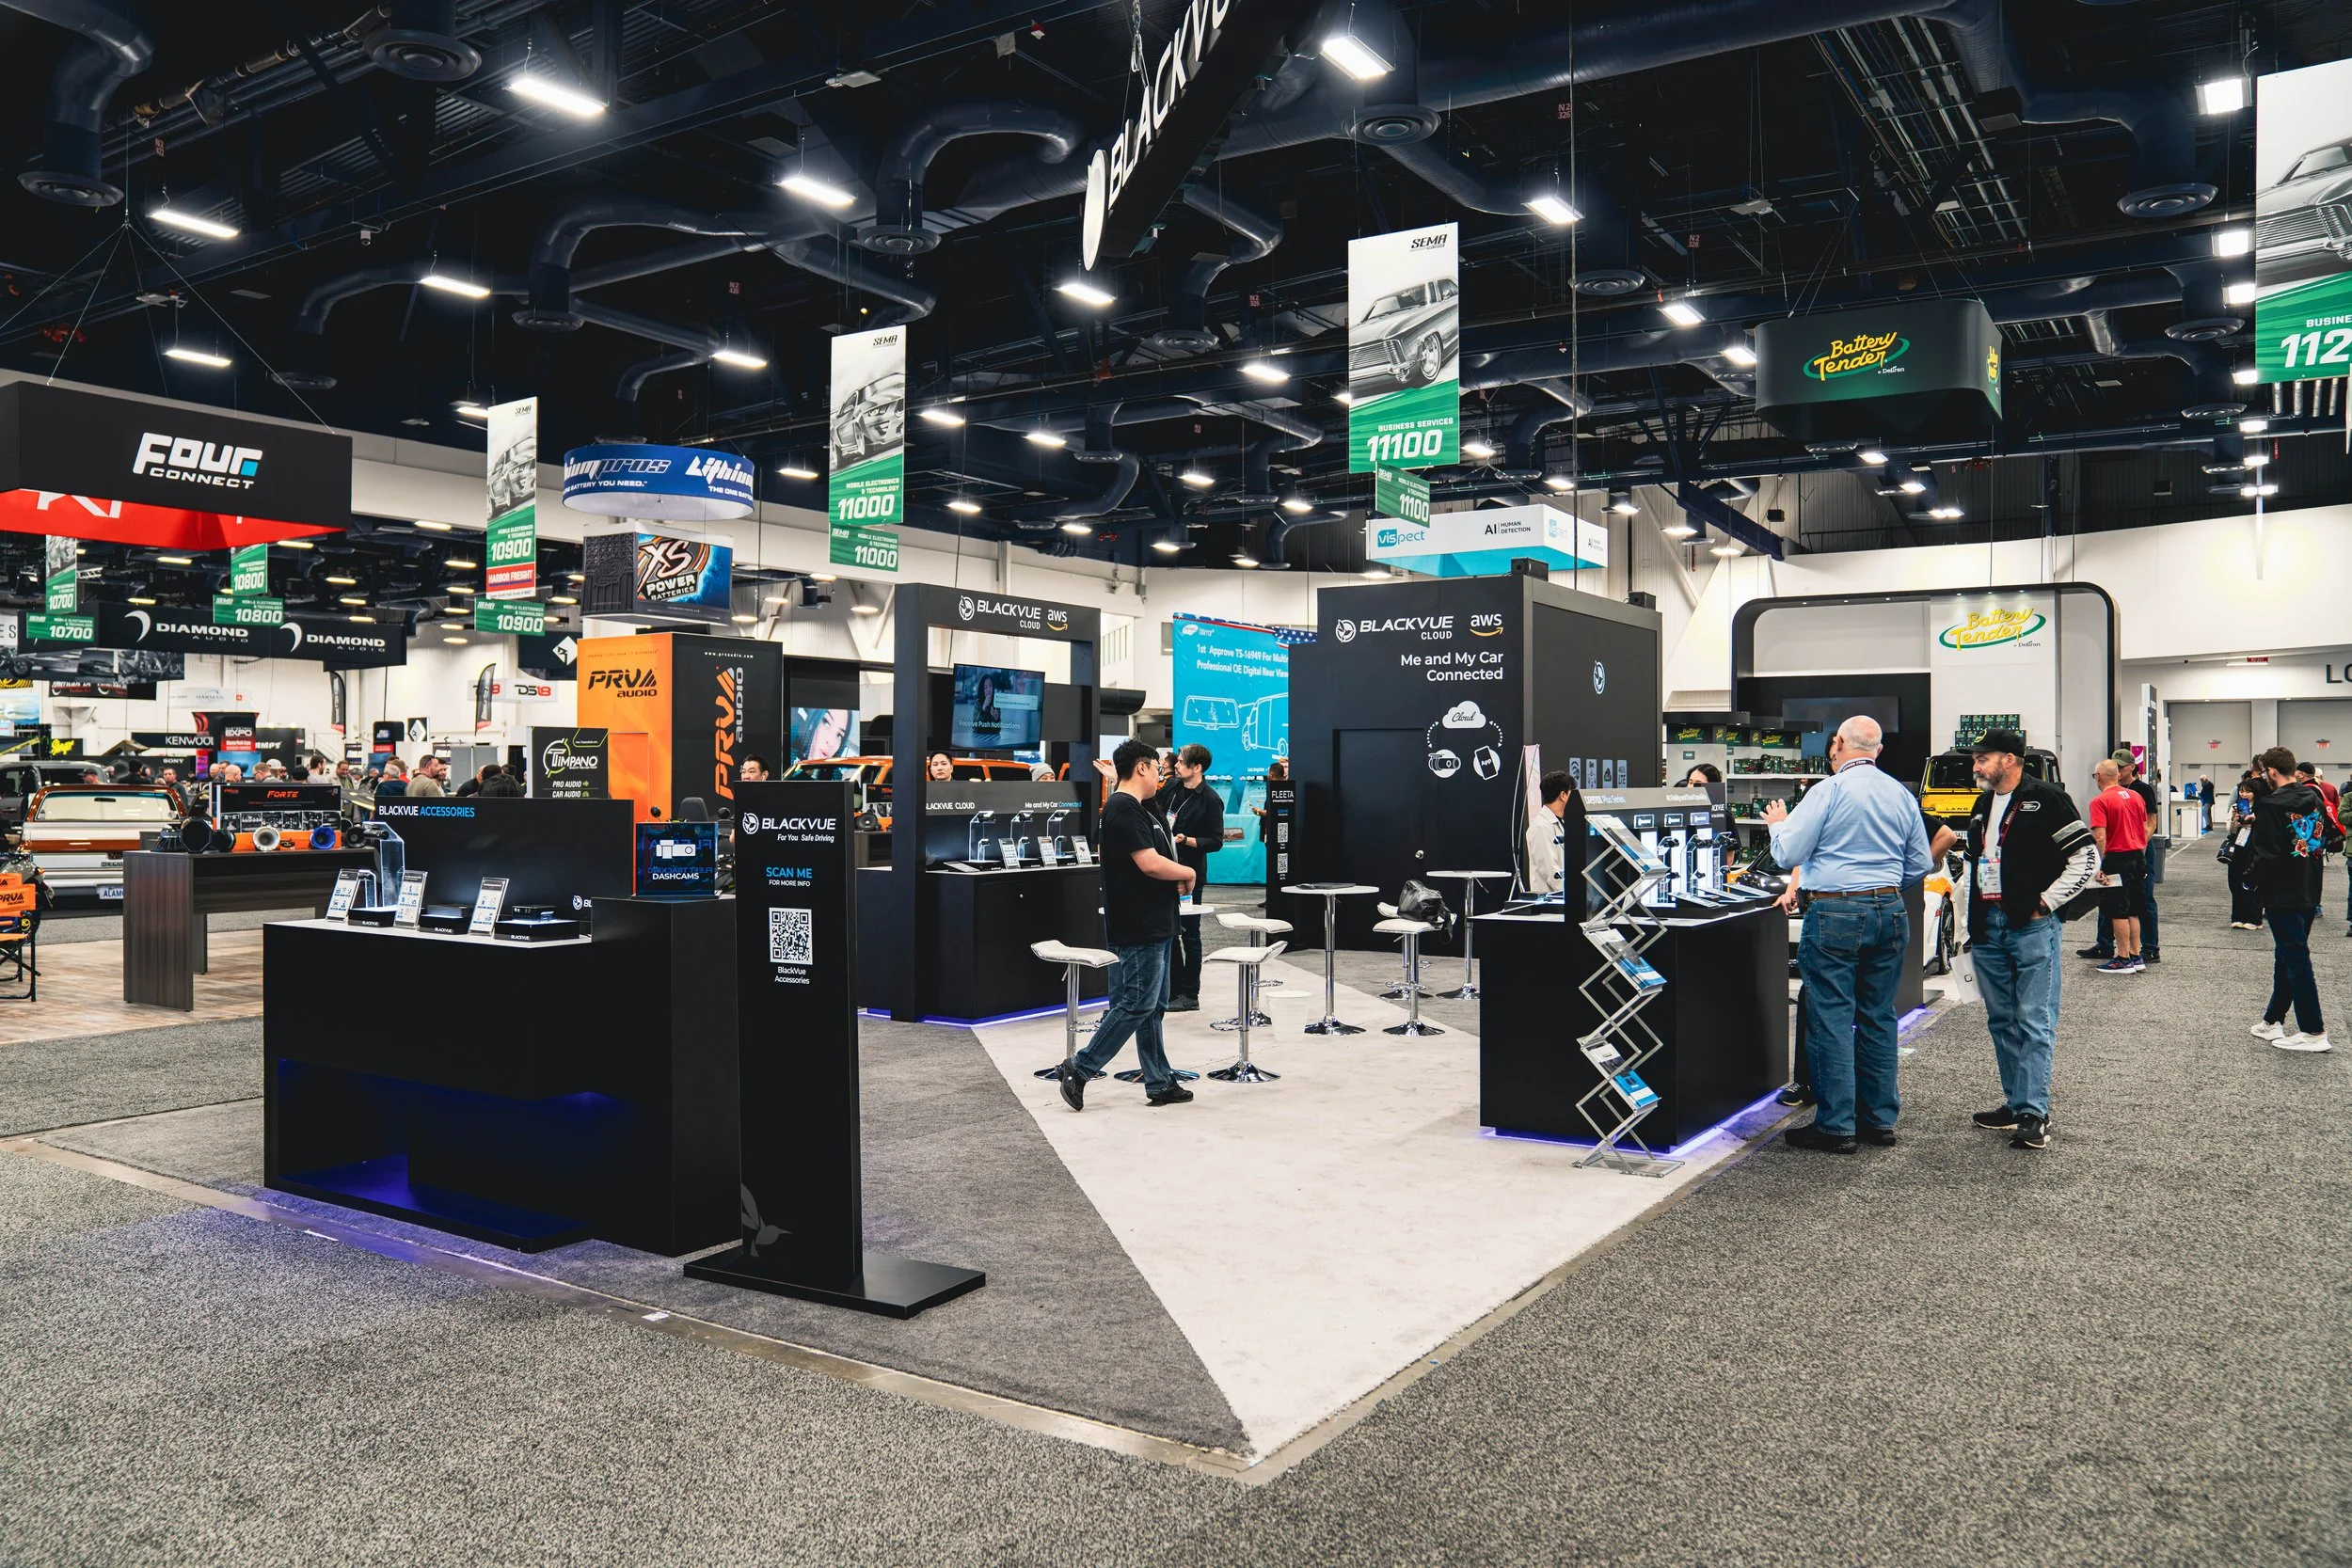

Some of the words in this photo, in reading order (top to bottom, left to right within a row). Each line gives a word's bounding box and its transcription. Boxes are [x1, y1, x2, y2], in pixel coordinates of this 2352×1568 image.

[1558, 111, 1570, 119] 326
[1411, 234, 1447, 248] SEMA
[2306, 314, 2352, 328] BUSINE
[873, 335, 898, 345] SEMA
[1831, 332, 1898, 358] Battery
[2280, 327, 2352, 368] 112
[1814, 349, 1885, 381] Tender
[515, 404, 532, 415] SEMA
[1377, 421, 1415, 432] BUSINESS
[1417, 418, 1454, 428] SERVICES
[1366, 429, 1442, 462] 11100
[133, 432, 263, 476] FOUR
[150, 467, 254, 489] CONNECT
[846, 481, 865, 489] MOBILE
[865, 478, 899, 487] ELECTRONICS
[571, 482, 596, 491] BATTERY
[724, 487, 738, 496] ONE
[866, 485, 899, 494] TECHNOLOGY
[838, 494, 895, 520] 11000
[1400, 494, 1429, 522] 11100
[1485, 524, 1497, 535] AI
[872, 535, 898, 544] ELECTRONICS
[1377, 529, 1425, 546] vispect
[491, 538, 532, 562] 10900
[873, 541, 897, 549] TECHNOLOGY
[854, 546, 898, 568] 11000
[637, 540, 692, 593] XS
[234, 571, 264, 591] 10800
[488, 572, 510, 584] HARBOR
[511, 569, 533, 581] FREIGHT
[646, 574, 695, 595] POWER
[651, 586, 694, 601] BATTERIES
[49, 594, 73, 610] 10700
[235, 609, 283, 624] 10800
[977, 600, 1041, 619] BLACKVUE
[1047, 610, 1068, 622] aws
[497, 614, 543, 632] 10900
[1019, 620, 1041, 629] CLOUD
[1359, 615, 1454, 632] BLACKVUE
[1470, 613, 1502, 627] aws
[1966, 608, 2034, 630] Battery
[50, 626, 93, 639] 10700
[156, 623, 248, 637] DIAMOND
[1421, 630, 1453, 640] CLOUD
[192, 635, 249, 643] AUDIO
[307, 634, 386, 647] DIAMOND
[1949, 626, 2023, 651] Tender
[1197, 644, 1206, 653] 1st
[1209, 645, 1234, 657] Approve
[1263, 652, 1272, 661] For
[1401, 654, 1422, 666] Me
[1424, 653, 1451, 665] and
[1454, 652, 1476, 667] My
[1479, 651, 1503, 663] Car
[1197, 660, 1232, 673] Professional
[1232, 663, 1242, 673] OE
[1244, 665, 1262, 677] Digital
[1263, 667, 1274, 676] Rear
[1426, 668, 1503, 682] Connected
[515, 684, 551, 696] DS18
[1452, 712, 1476, 722] Cloud
[266, 790, 299, 799] FORTE
[378, 805, 419, 816] BLACKVUE
[420, 806, 475, 817] ACCESSORIES
[1043, 801, 1050, 810] My
[761, 817, 836, 831] BLACKVUE
[801, 833, 814, 842] Safe
[815, 834, 834, 843] Driving
[766, 866, 794, 879] SCAN
[797, 867, 813, 879] ME
[777, 966, 806, 975] BlackVue
[774, 975, 810, 985] Accessories
